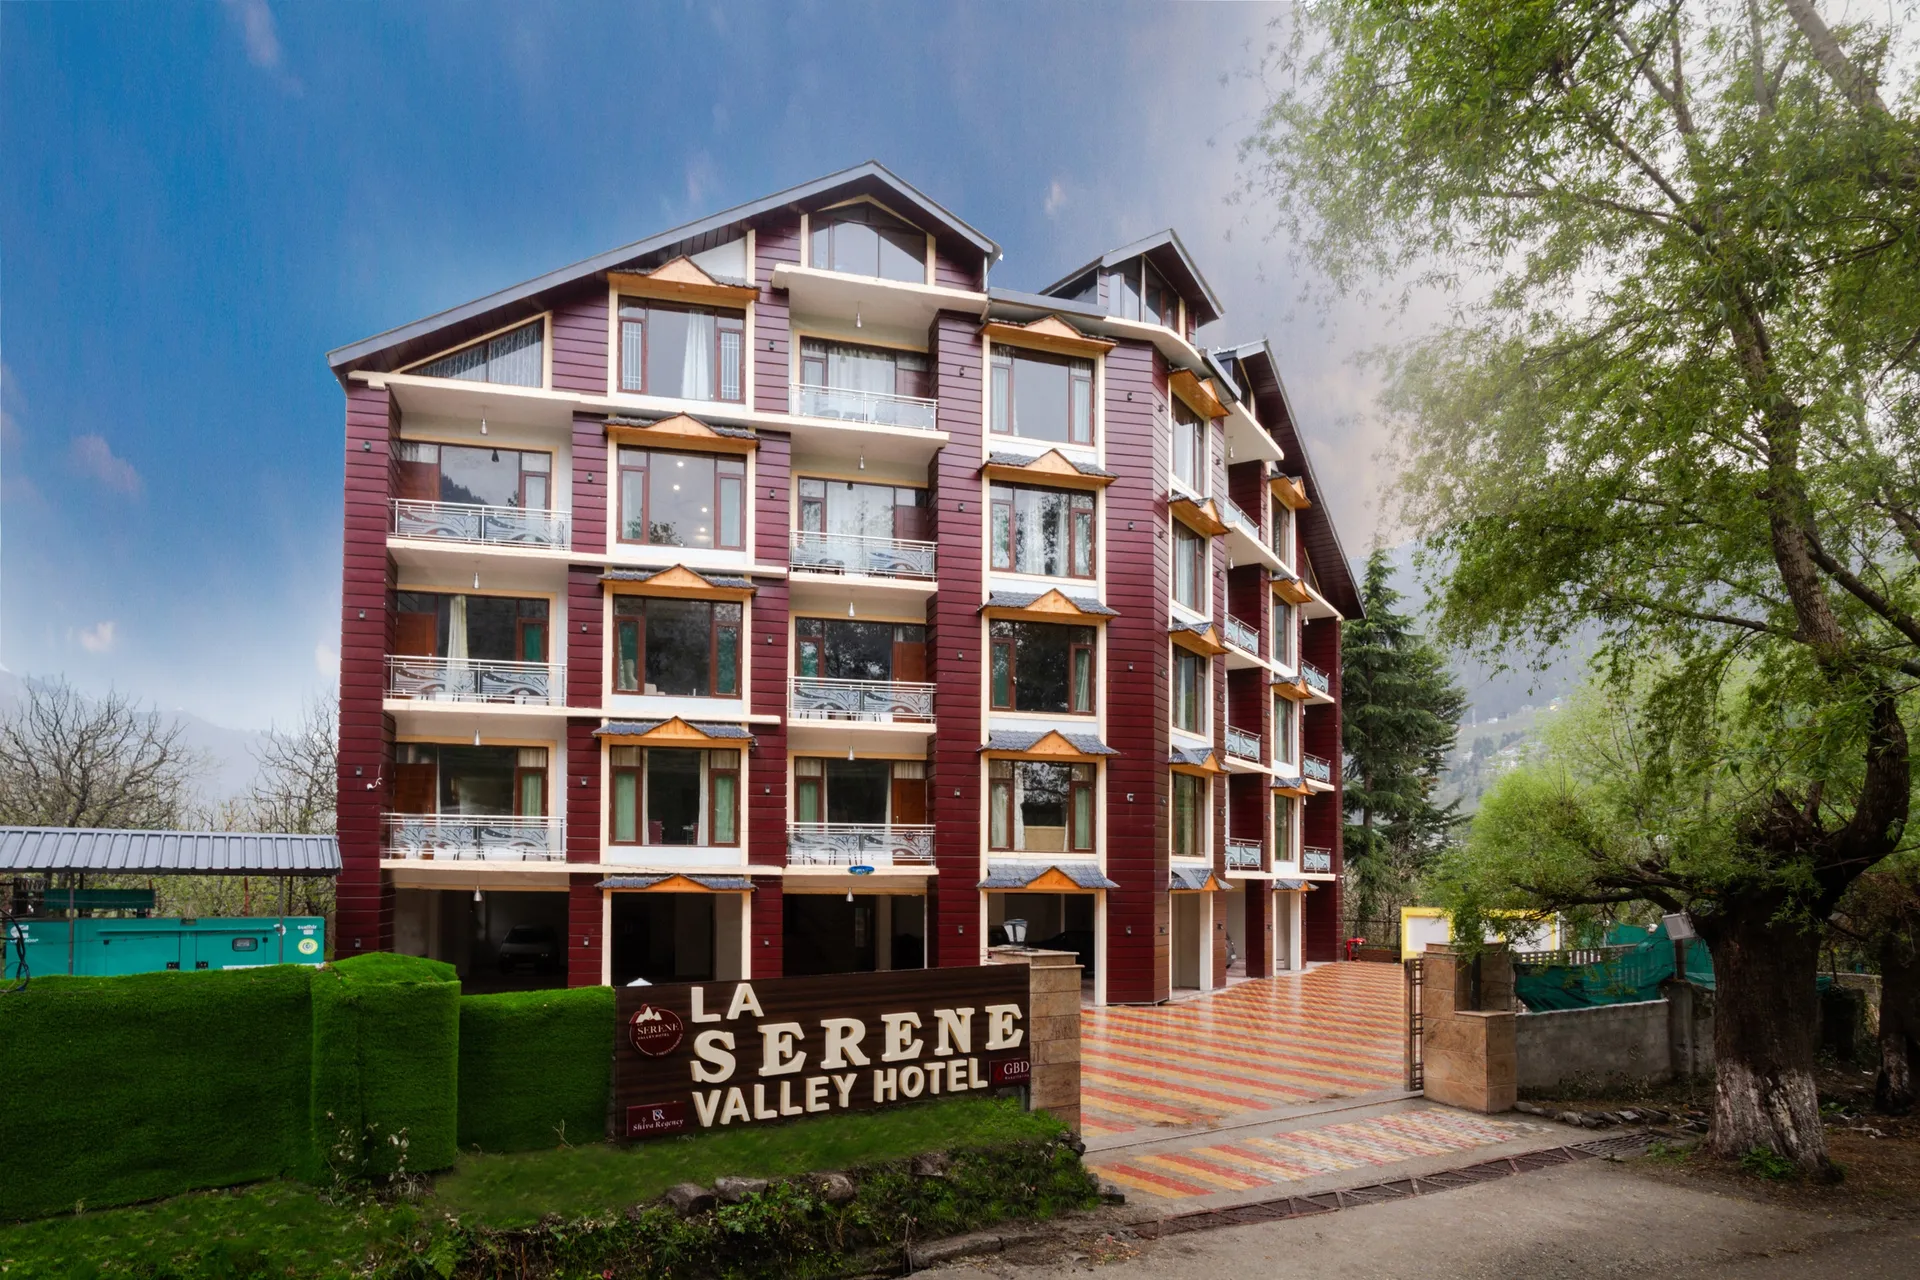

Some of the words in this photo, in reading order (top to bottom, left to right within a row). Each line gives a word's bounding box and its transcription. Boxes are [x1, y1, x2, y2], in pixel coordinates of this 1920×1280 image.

[690, 982, 765, 1023] LA
[637, 1023, 680, 1036] SERENE
[690, 1003, 1025, 1084] SERENE
[1003, 1061, 1030, 1075] GBD
[691, 1073, 858, 1128] VALLEY
[873, 1057, 989, 1103] HOTEL
[632, 1117, 654, 1131] Shiva
[655, 1119, 684, 1130] Regency
